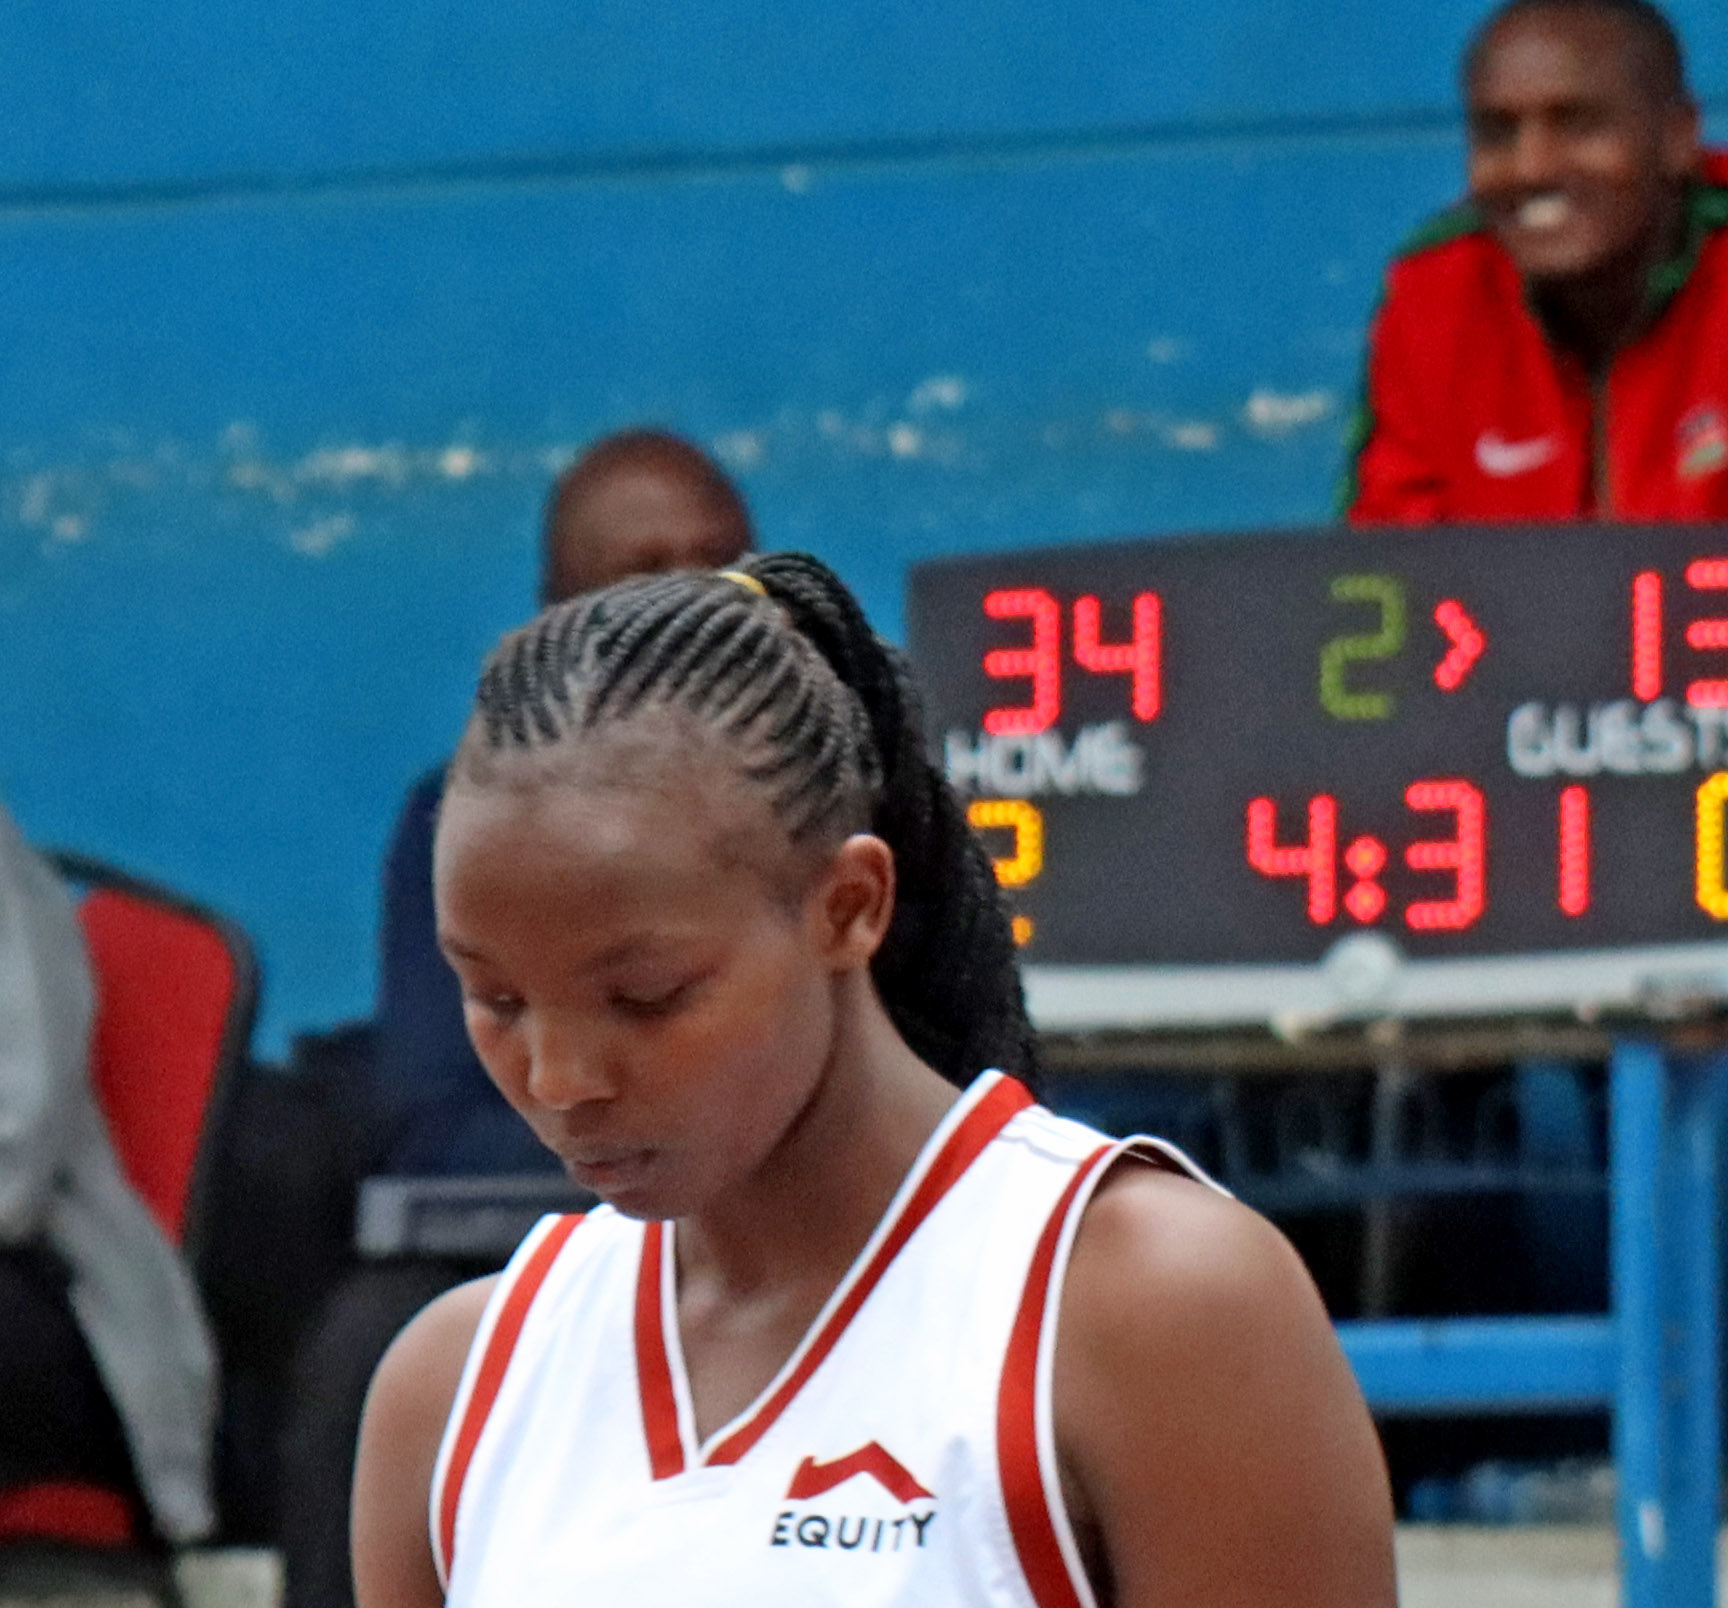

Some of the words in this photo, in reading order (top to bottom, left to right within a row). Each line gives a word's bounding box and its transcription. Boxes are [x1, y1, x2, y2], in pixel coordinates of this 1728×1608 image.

[983, 586, 1161, 735] 34
[1319, 573, 1406, 720] 2
[945, 722, 1144, 796] HOME
[1246, 777, 1592, 932] 4:31
[770, 1511, 936, 1553] EQUITY
